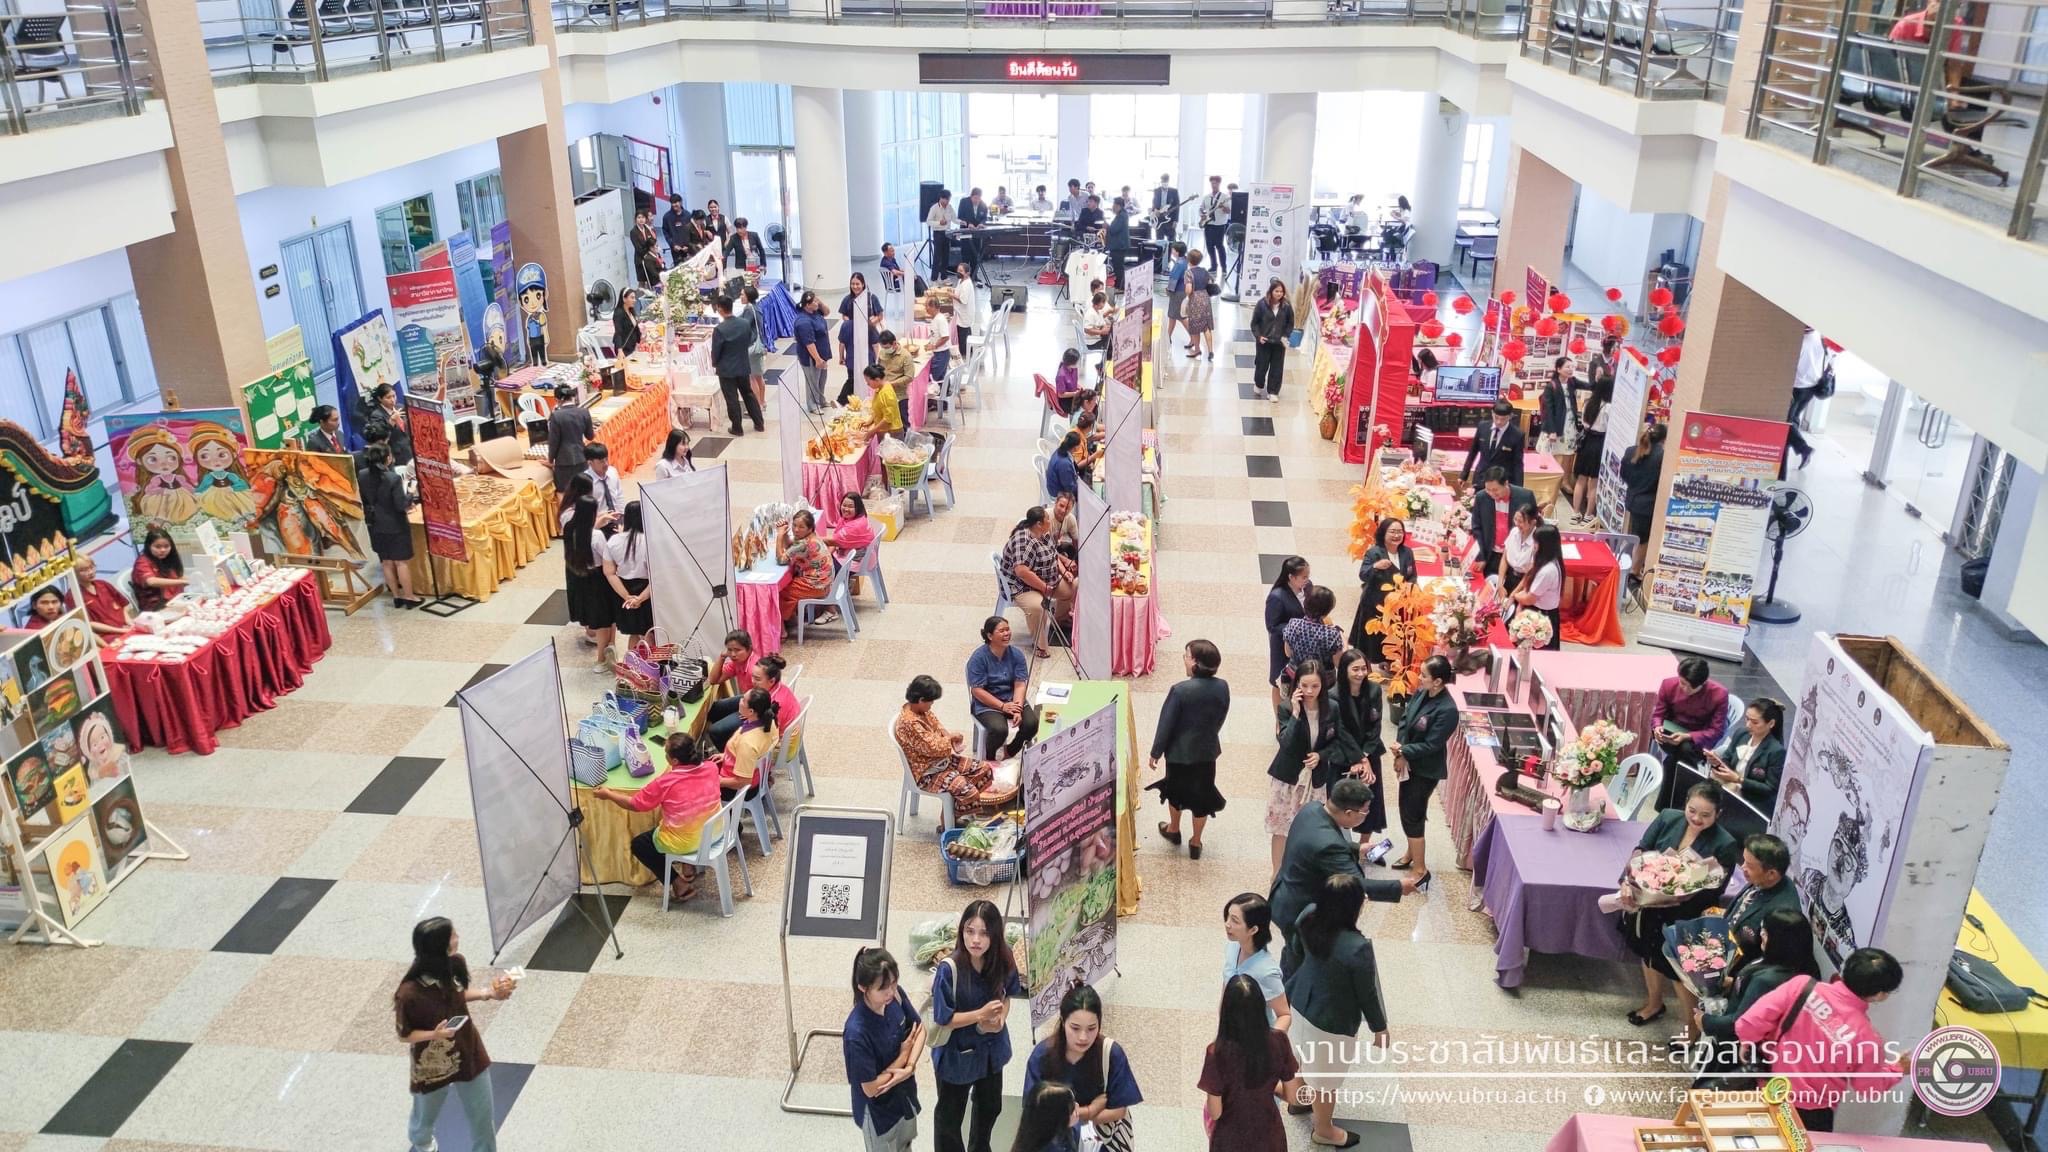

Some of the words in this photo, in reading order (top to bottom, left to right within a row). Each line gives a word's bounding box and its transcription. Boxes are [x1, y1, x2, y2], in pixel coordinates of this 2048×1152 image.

[1008, 61, 1078, 77] ยินดีต้อนรับ
